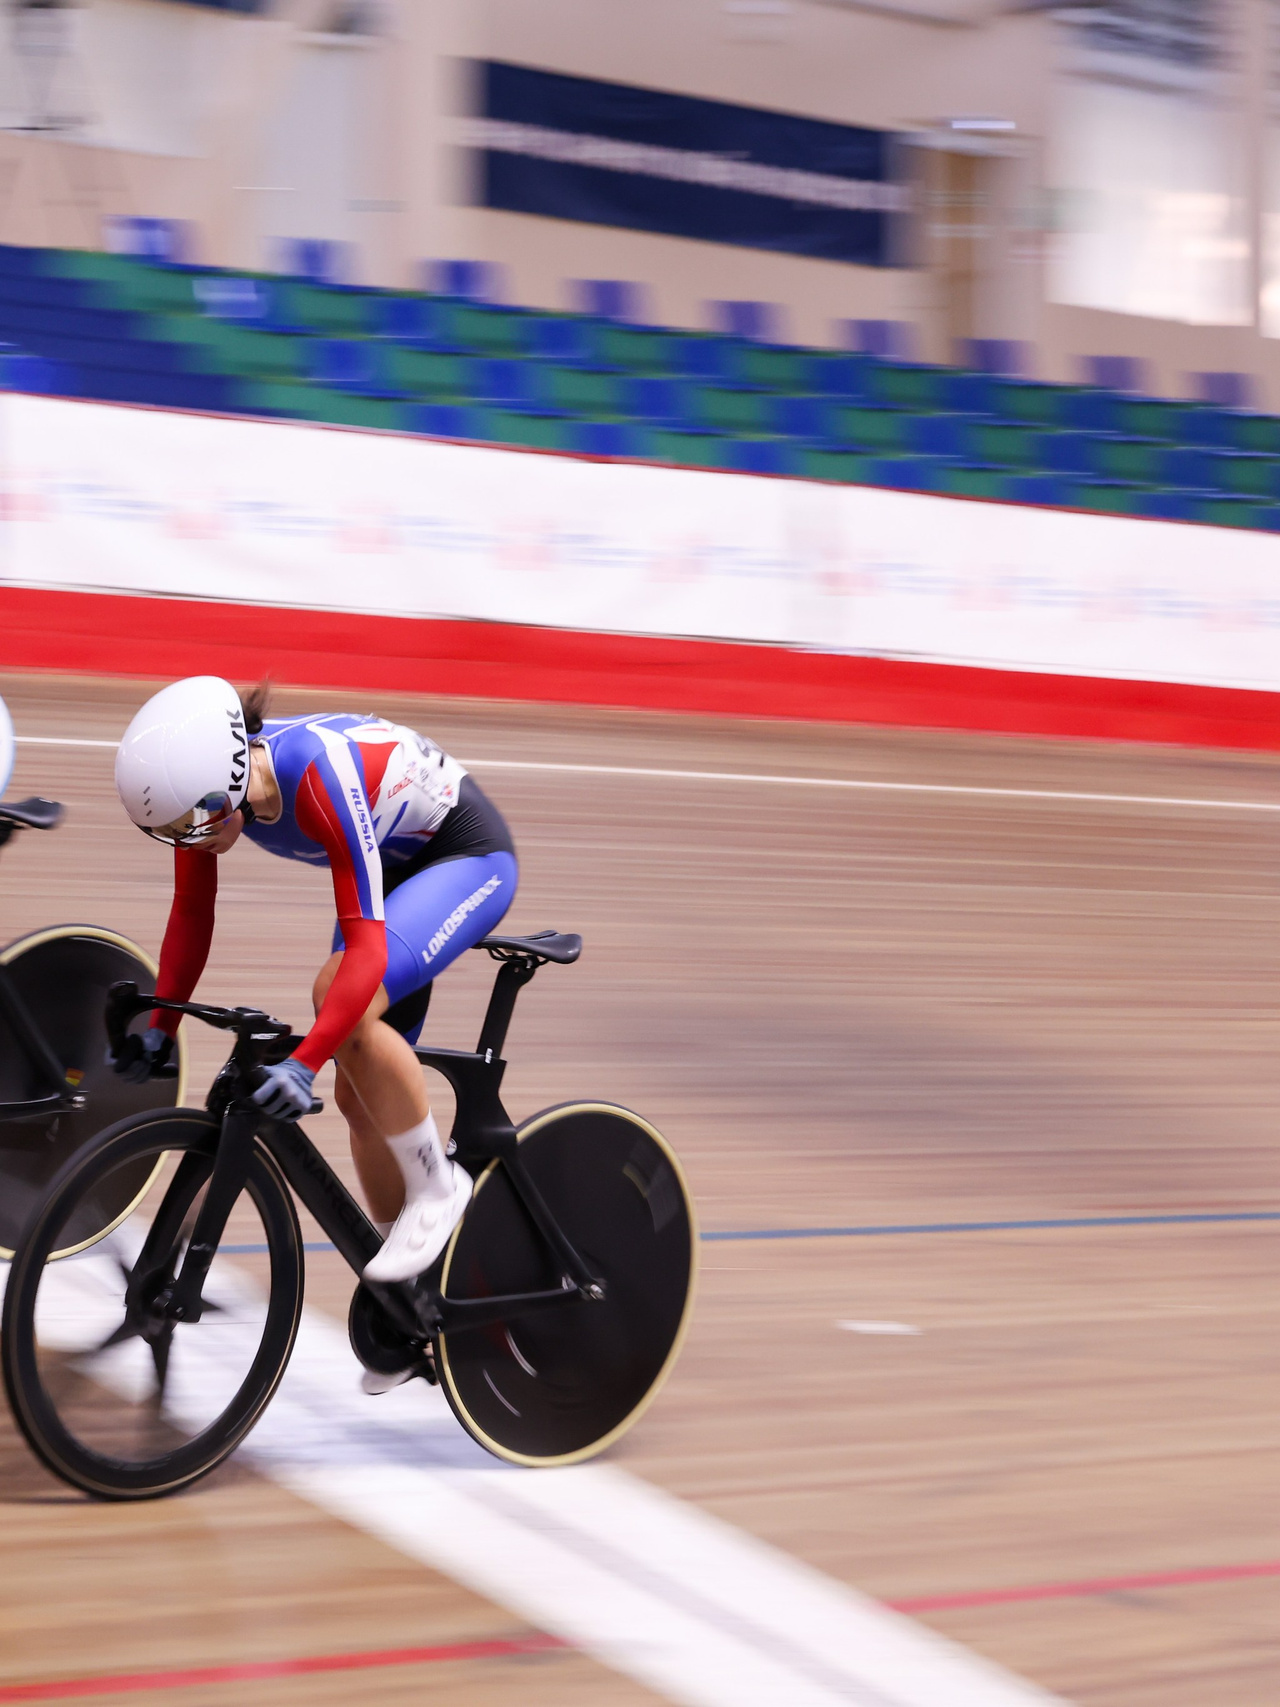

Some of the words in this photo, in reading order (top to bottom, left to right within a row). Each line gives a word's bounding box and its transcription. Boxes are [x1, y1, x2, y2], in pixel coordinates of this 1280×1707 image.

[226, 709, 246, 791] KASK
[350, 788, 374, 853] RUSSIA
[421, 873, 503, 964] LOKOSPHINX
